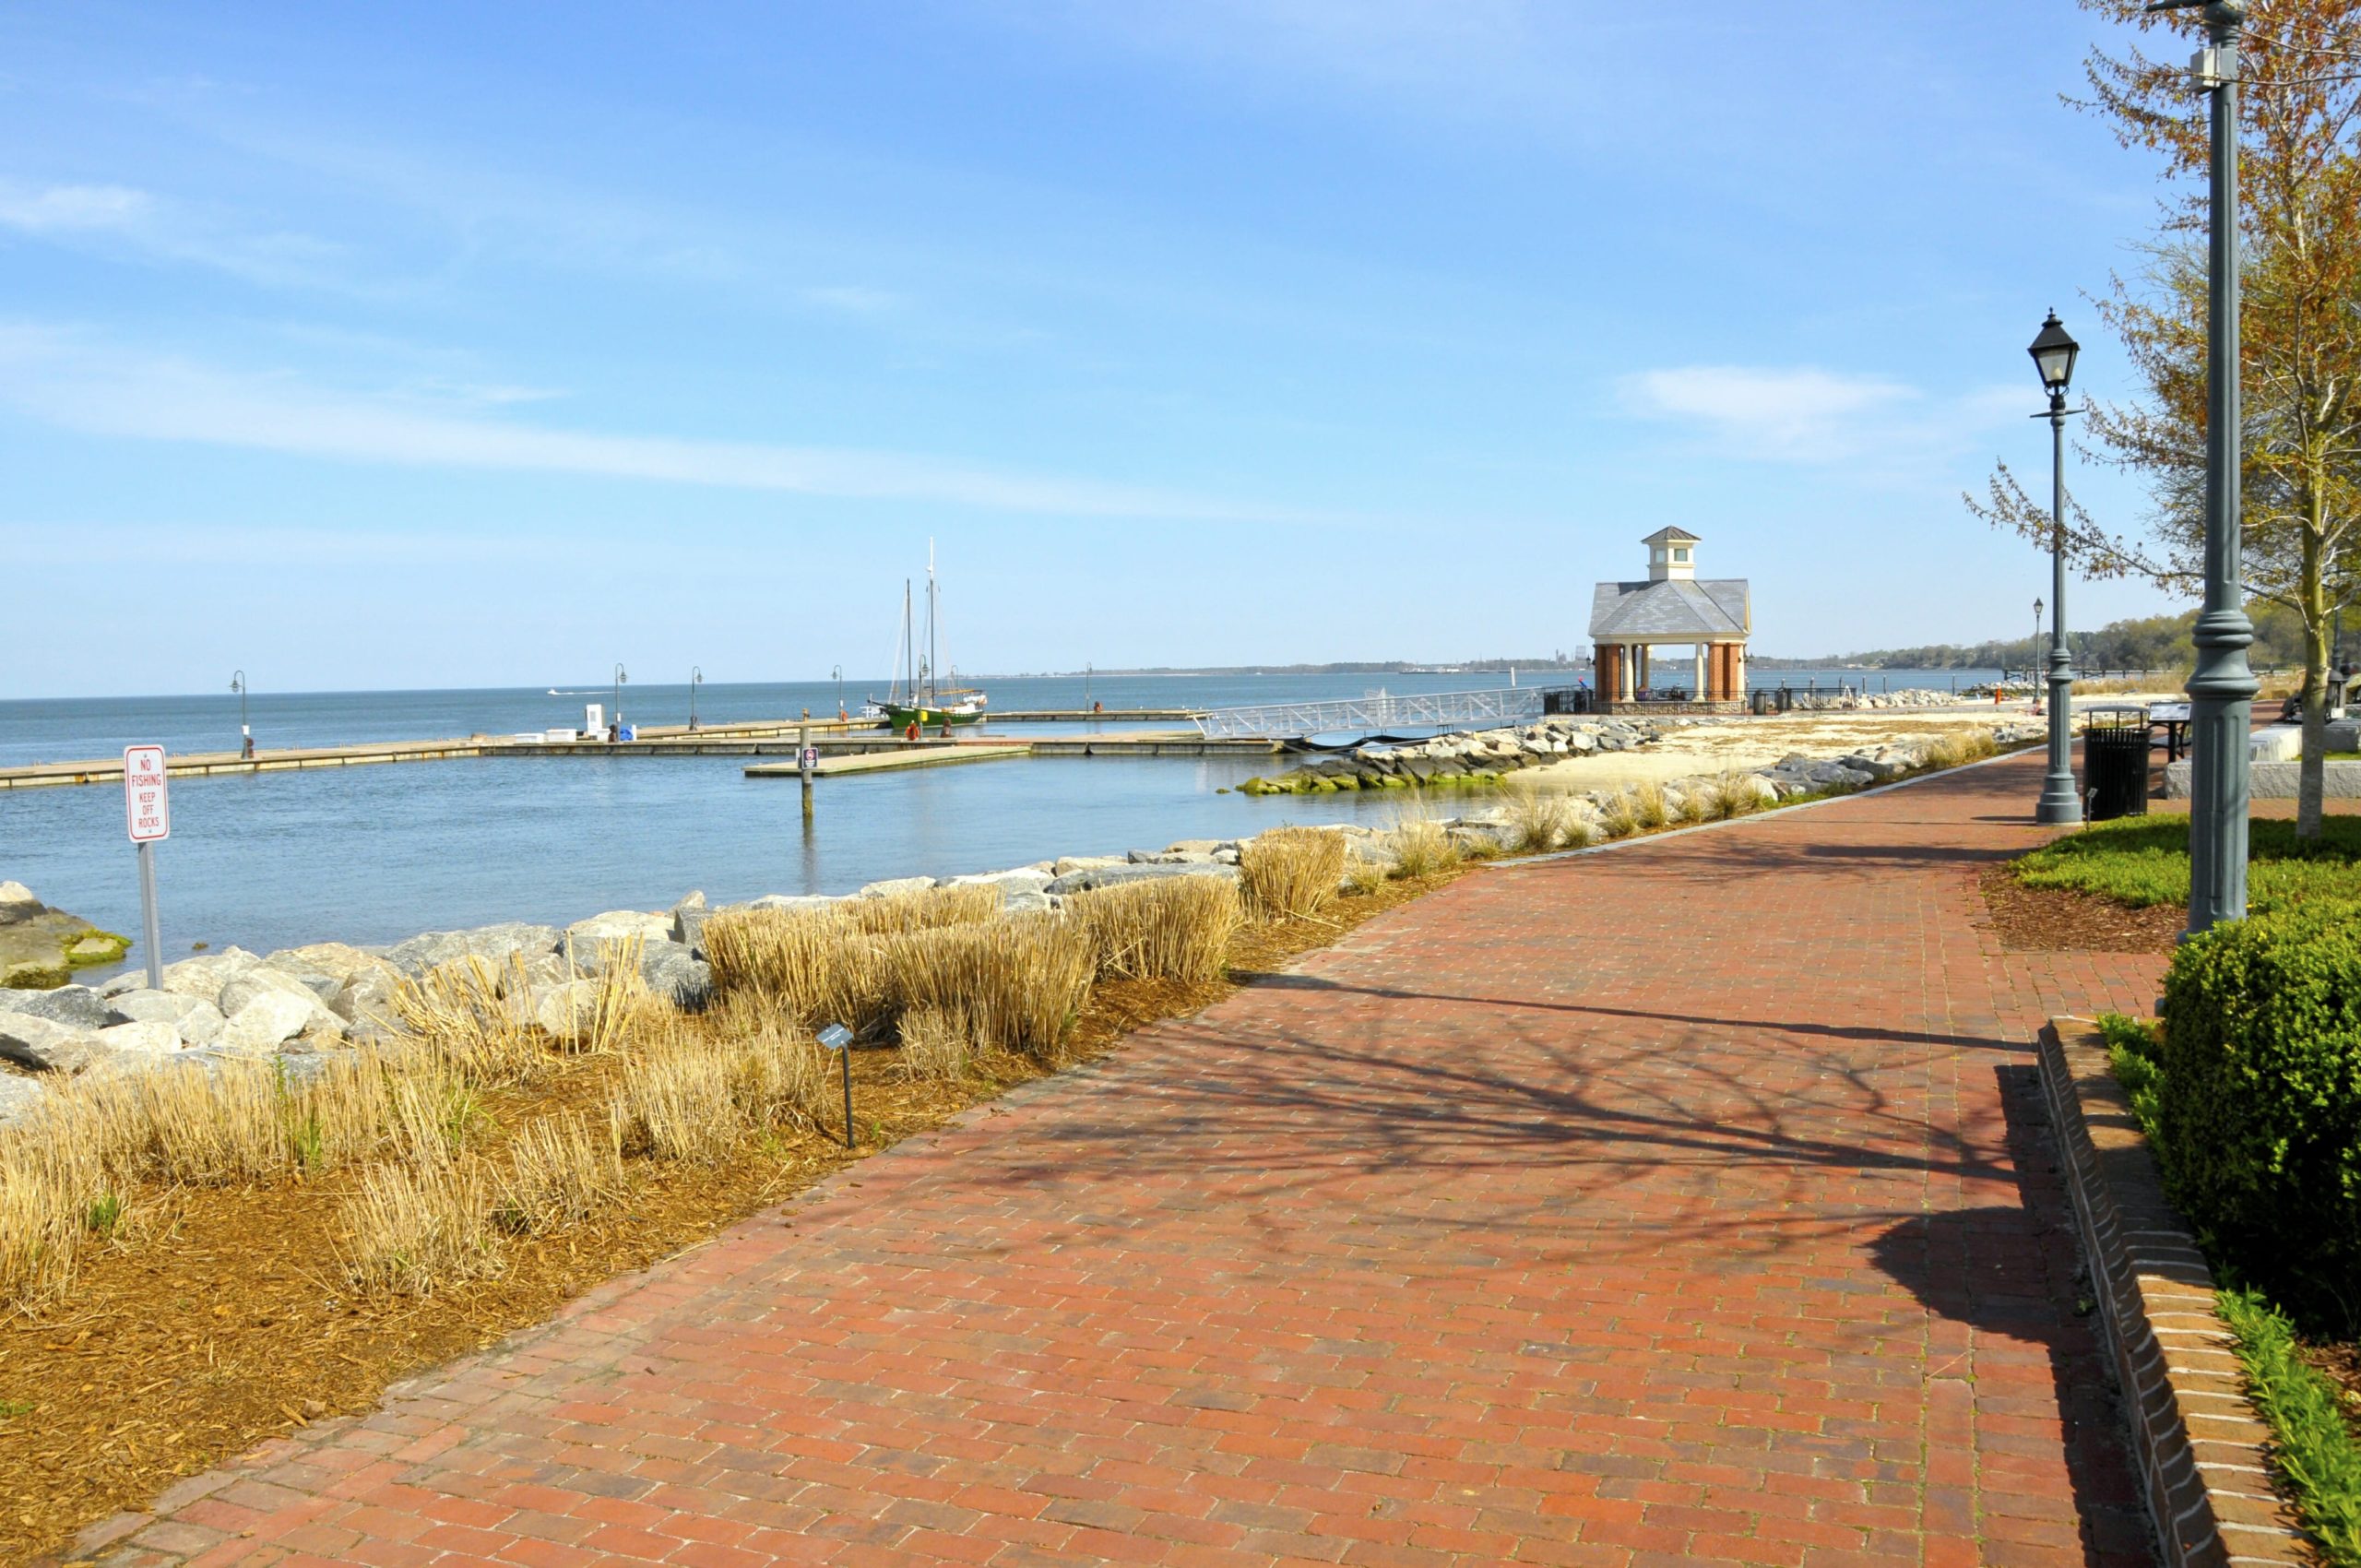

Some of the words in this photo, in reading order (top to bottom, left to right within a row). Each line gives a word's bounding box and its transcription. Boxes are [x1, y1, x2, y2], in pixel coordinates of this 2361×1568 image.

[140, 758, 151, 771] NO
[132, 774, 161, 787] FISHING
[139, 792, 155, 802] KEEP
[142, 804, 154, 815] OFF
[138, 817, 160, 828] ROCKS
